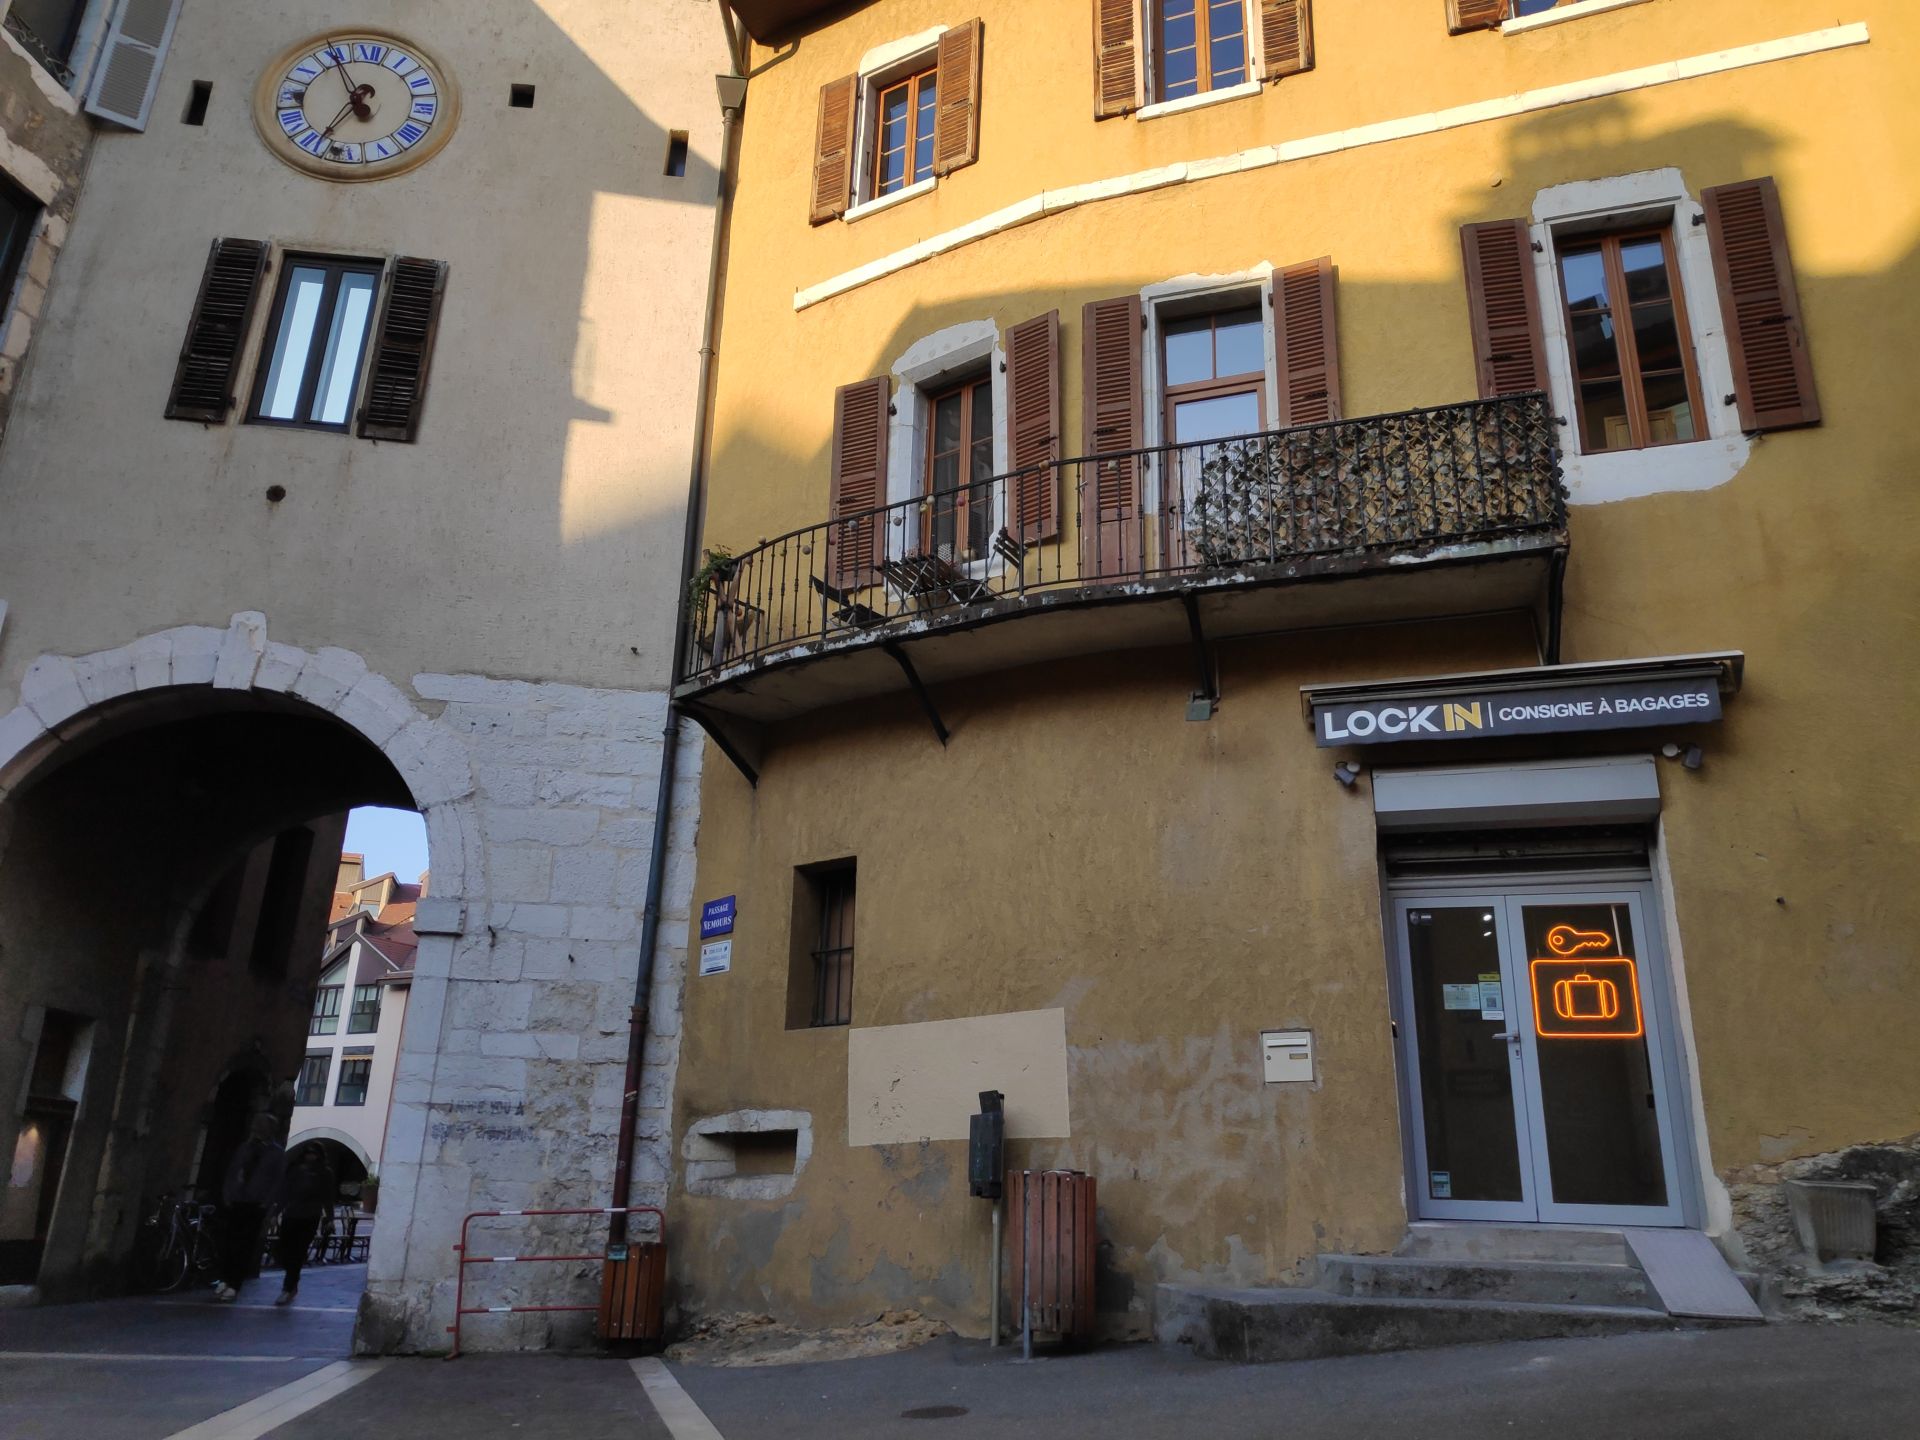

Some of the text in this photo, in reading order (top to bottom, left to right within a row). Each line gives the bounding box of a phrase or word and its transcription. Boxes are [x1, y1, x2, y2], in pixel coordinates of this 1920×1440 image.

[357, 44, 382, 62] XII
[410, 77, 430, 89] II
[413, 103, 434, 116] III
[397, 122, 424, 144] IIII
[1323, 692, 1710, 740] LOCK IN CONSIGNE À BAGAGES
[708, 903, 729, 916] PASSAGE
[703, 915, 732, 930] NEMOURS
